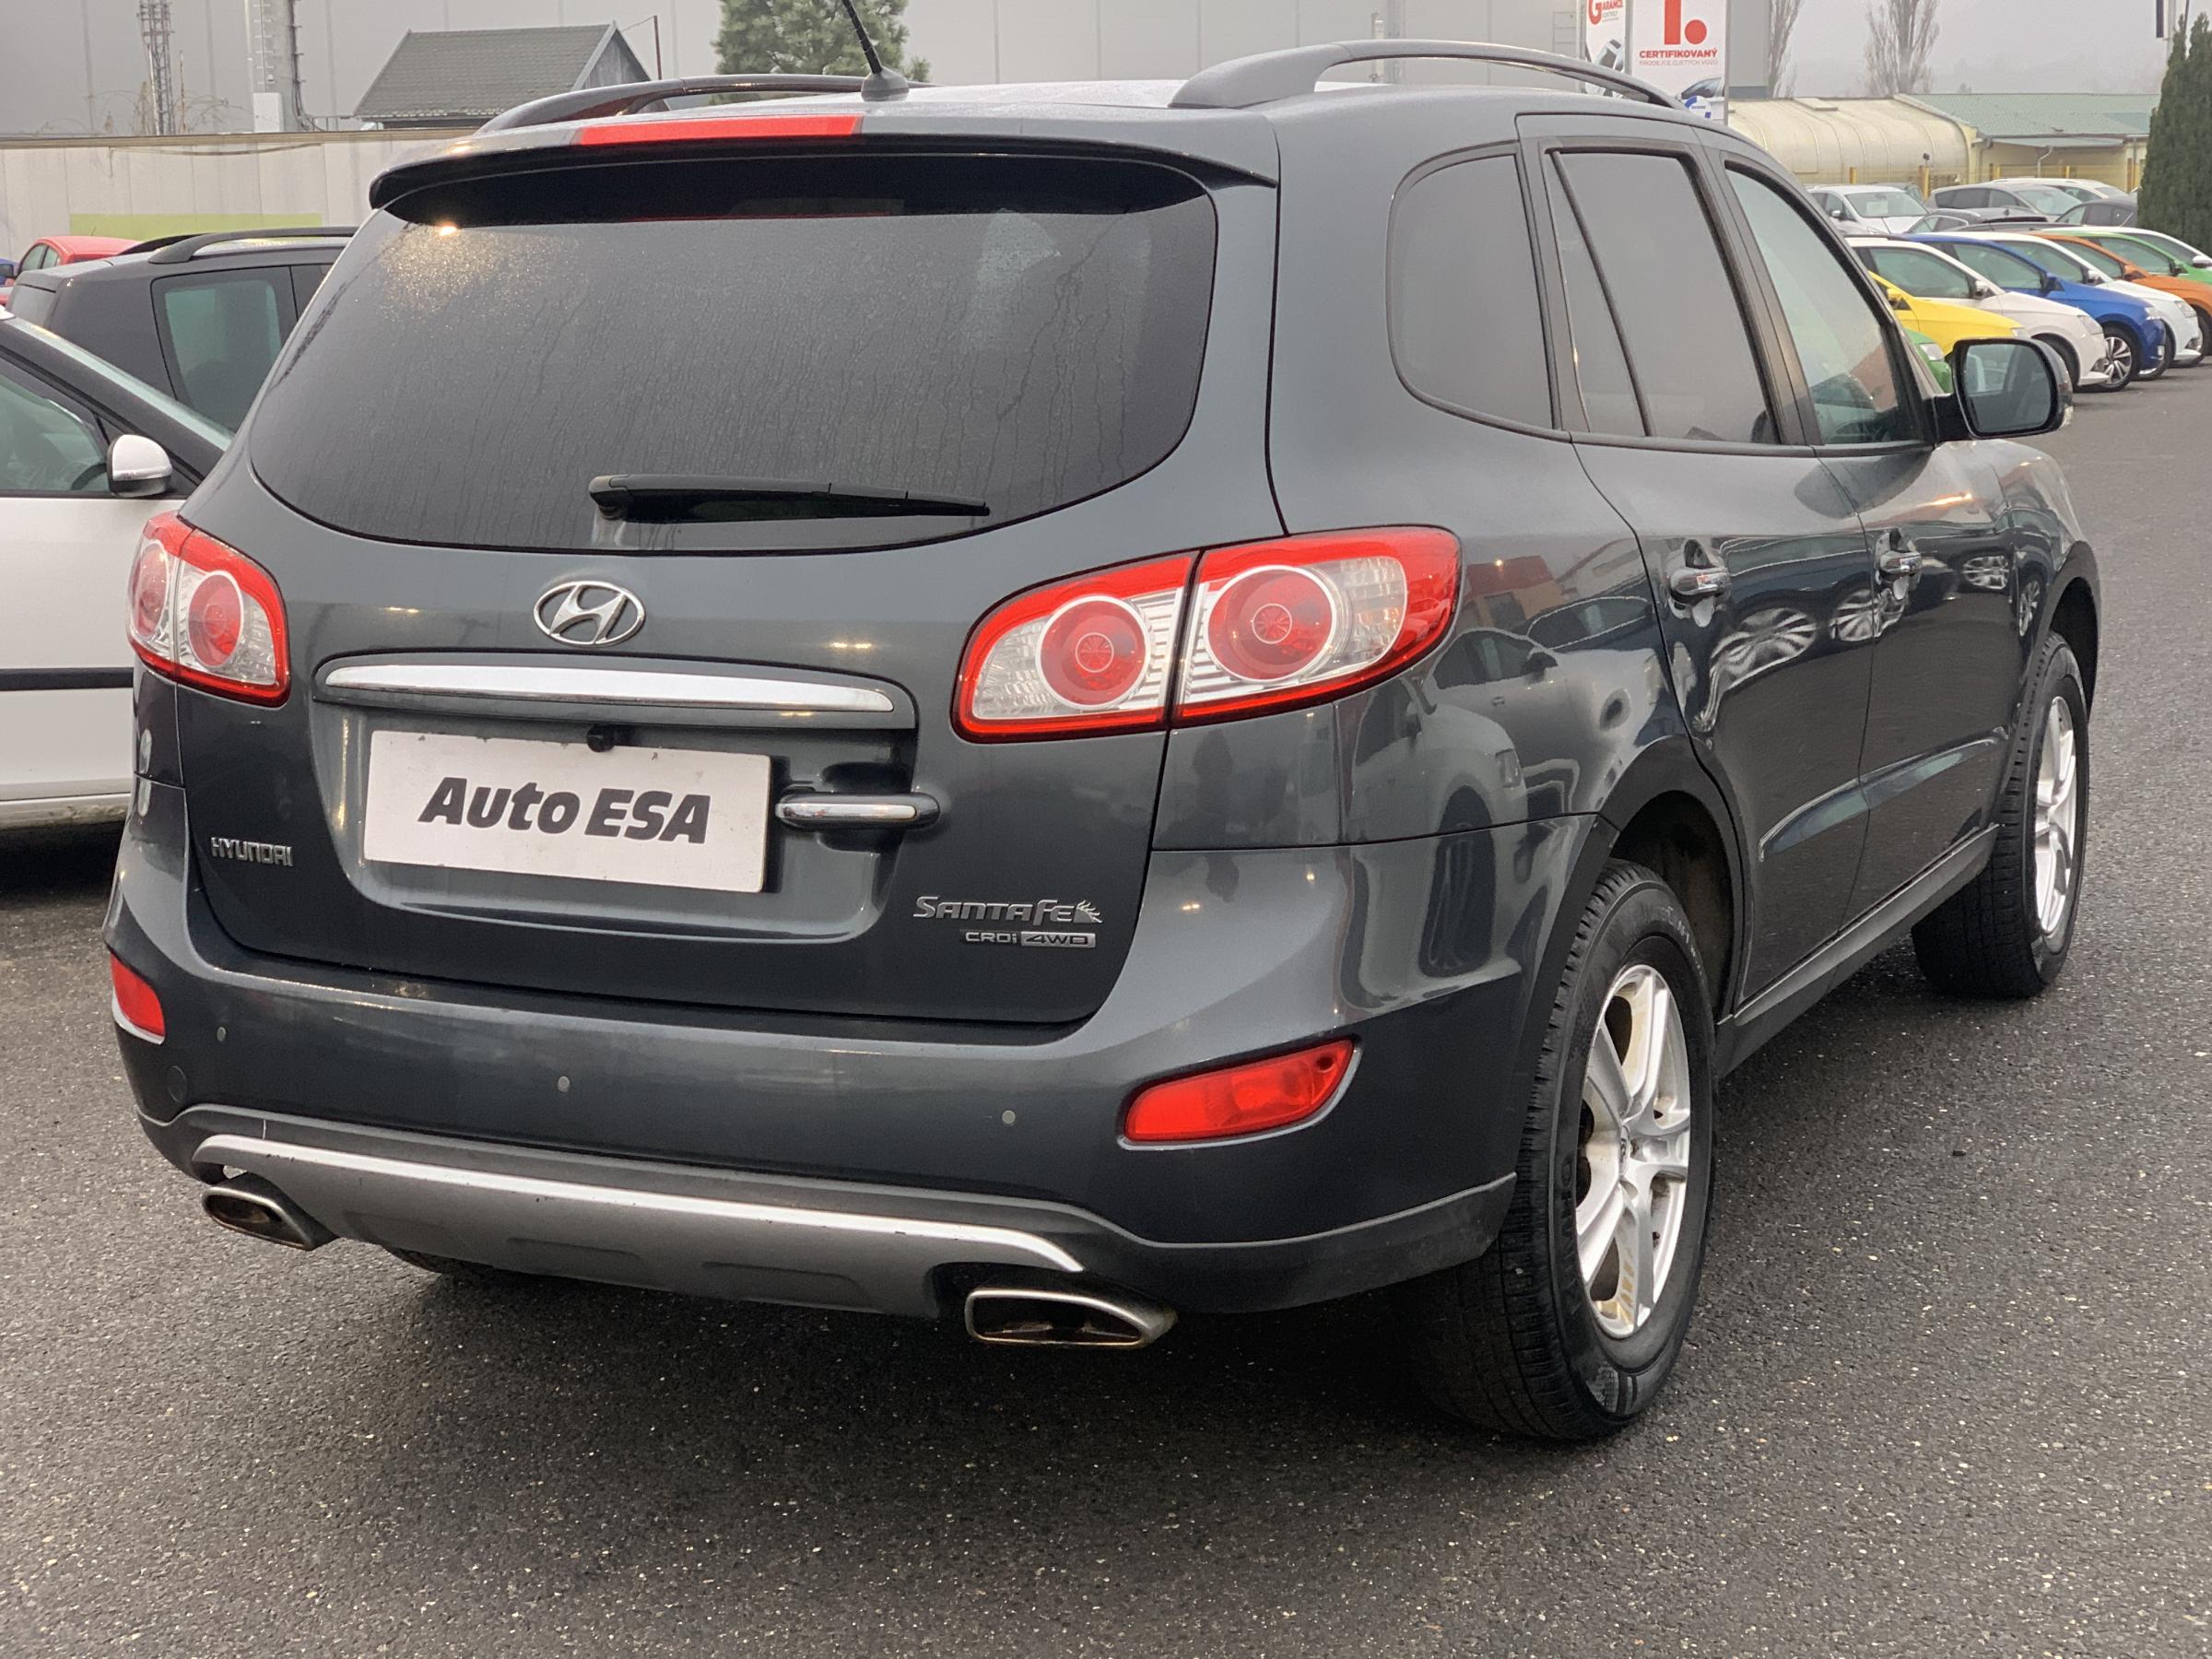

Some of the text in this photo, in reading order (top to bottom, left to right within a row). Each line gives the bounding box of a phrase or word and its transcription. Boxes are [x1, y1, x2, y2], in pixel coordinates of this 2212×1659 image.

[1639, 47, 1718, 59] CERTIFIKOVANÝ
[418, 777, 712, 844] Auto ESA
[210, 837, 294, 866] HYUNDAI
[1025, 934, 1088, 946] 4WD
